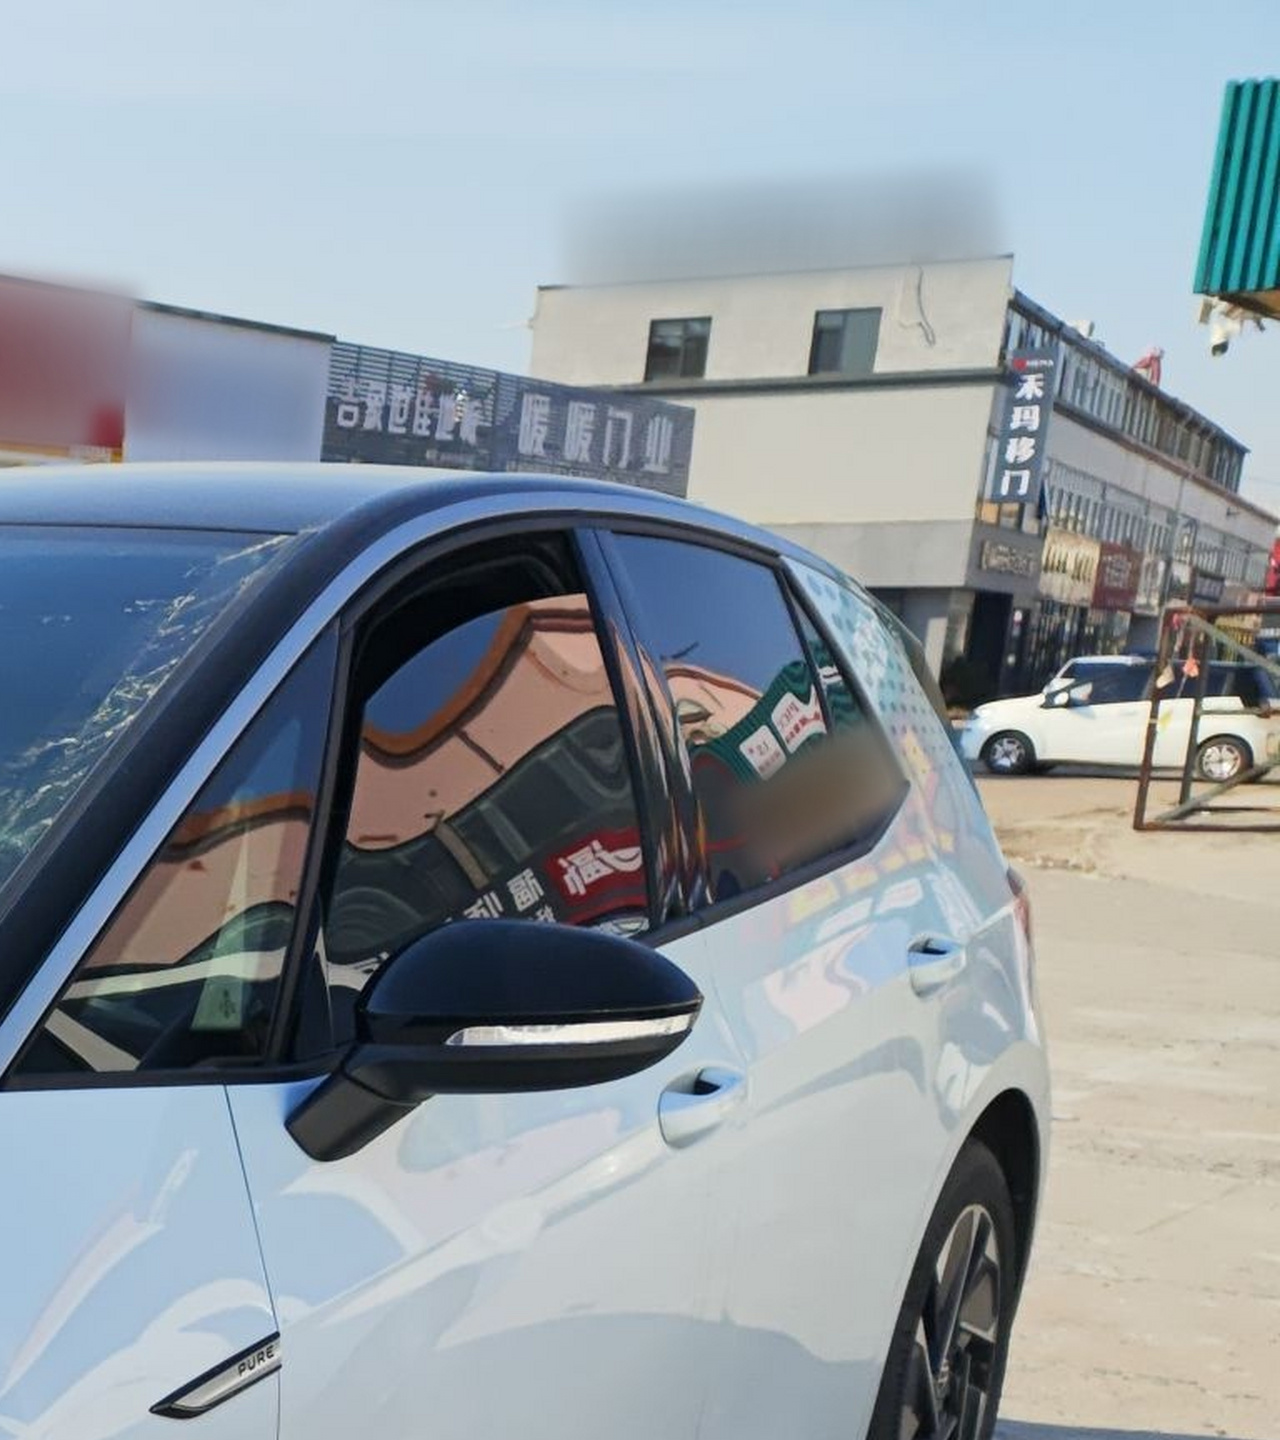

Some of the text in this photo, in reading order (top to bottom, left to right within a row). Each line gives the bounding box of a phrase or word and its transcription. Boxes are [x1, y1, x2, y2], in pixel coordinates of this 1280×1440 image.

[518, 393, 673, 474] 暖暖门业
[237, 1344, 275, 1377] PURE
